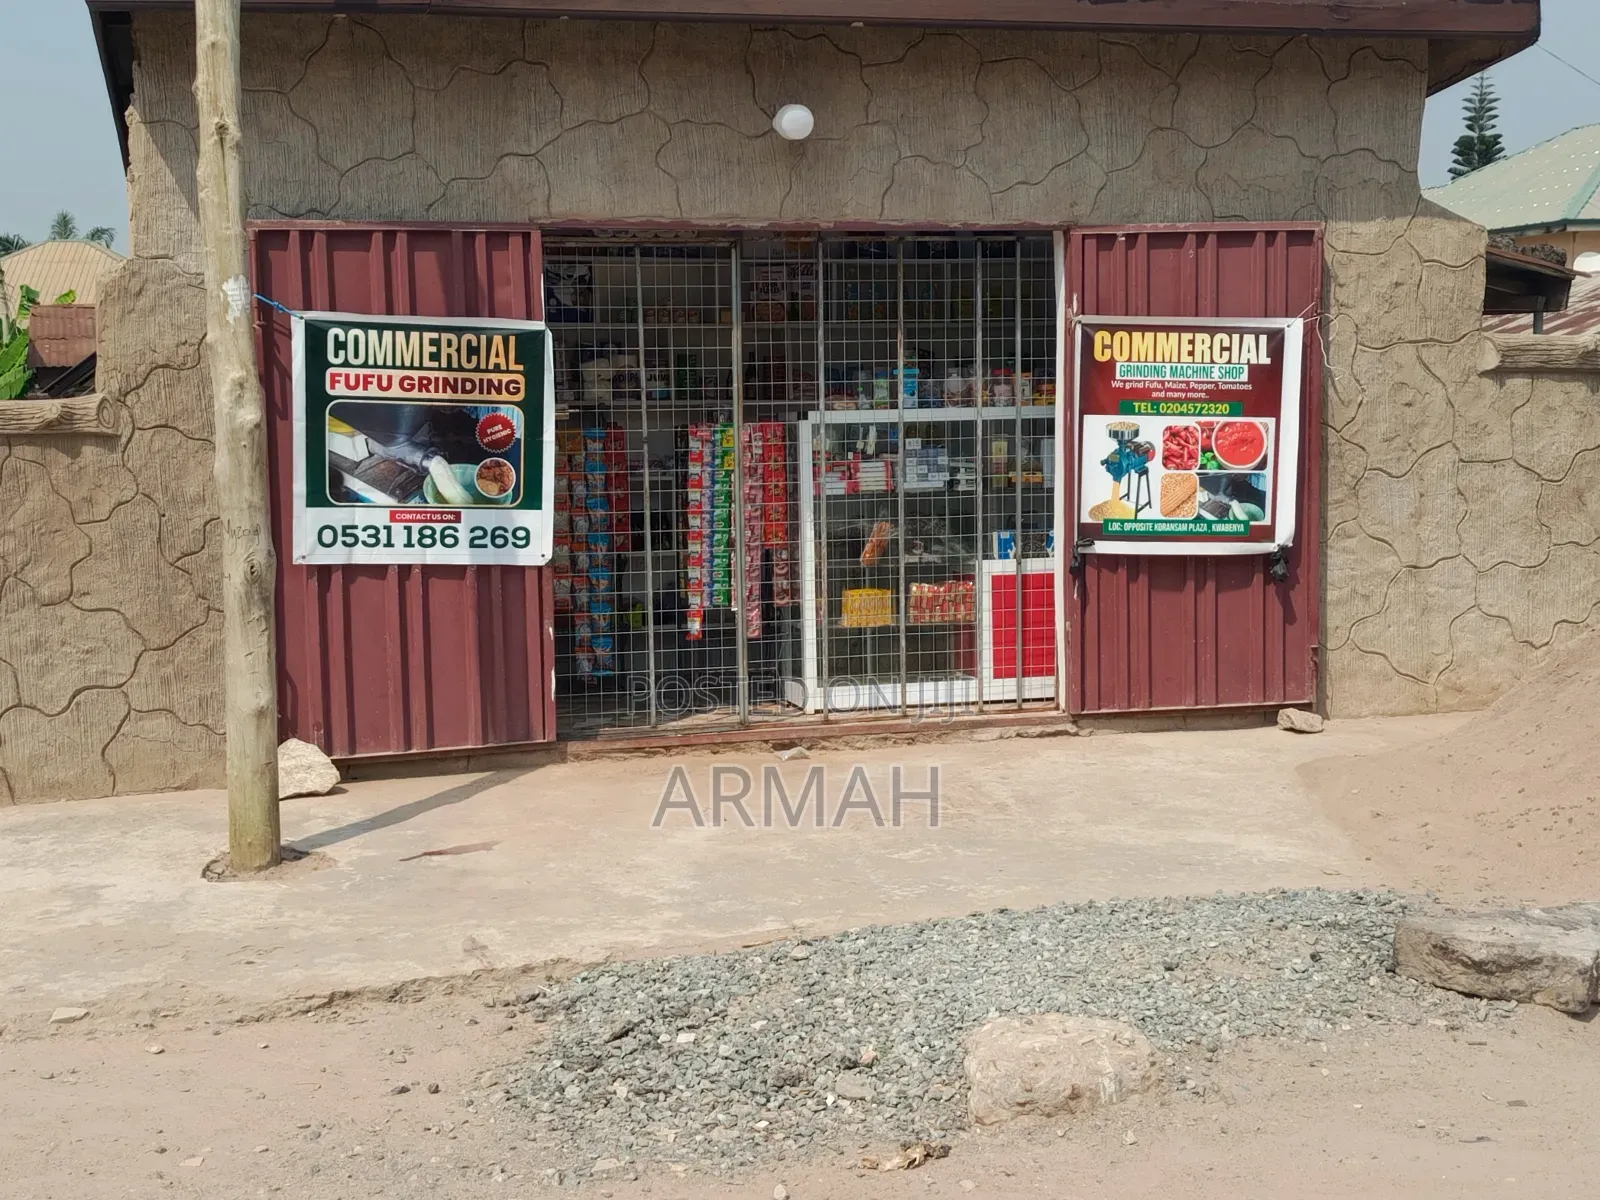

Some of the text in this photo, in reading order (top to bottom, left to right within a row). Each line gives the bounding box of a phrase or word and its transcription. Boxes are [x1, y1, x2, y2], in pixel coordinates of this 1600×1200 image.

[327, 327, 524, 371] COMMERCIAL
[1094, 330, 1271, 364] COMMERCIAL
[1119, 364, 1245, 380] GRINDING MACHINE SHOP
[329, 372, 521, 396] FUFU GRINDING
[1111, 380, 1124, 388] We
[1125, 380, 1144, 389] grind
[1151, 390, 1165, 398] and
[1166, 391, 1186, 399] many
[1133, 402, 1230, 415] TEL: 0204572320
[483, 428, 512, 443] HYGIENIC
[486, 424, 503, 434] PURE
[1108, 522, 1123, 531] LOC:
[1123, 522, 1153, 531] OPPOSITE
[1212, 523, 1245, 532] KWABENYA
[317, 524, 531, 549] 0531 186 269
